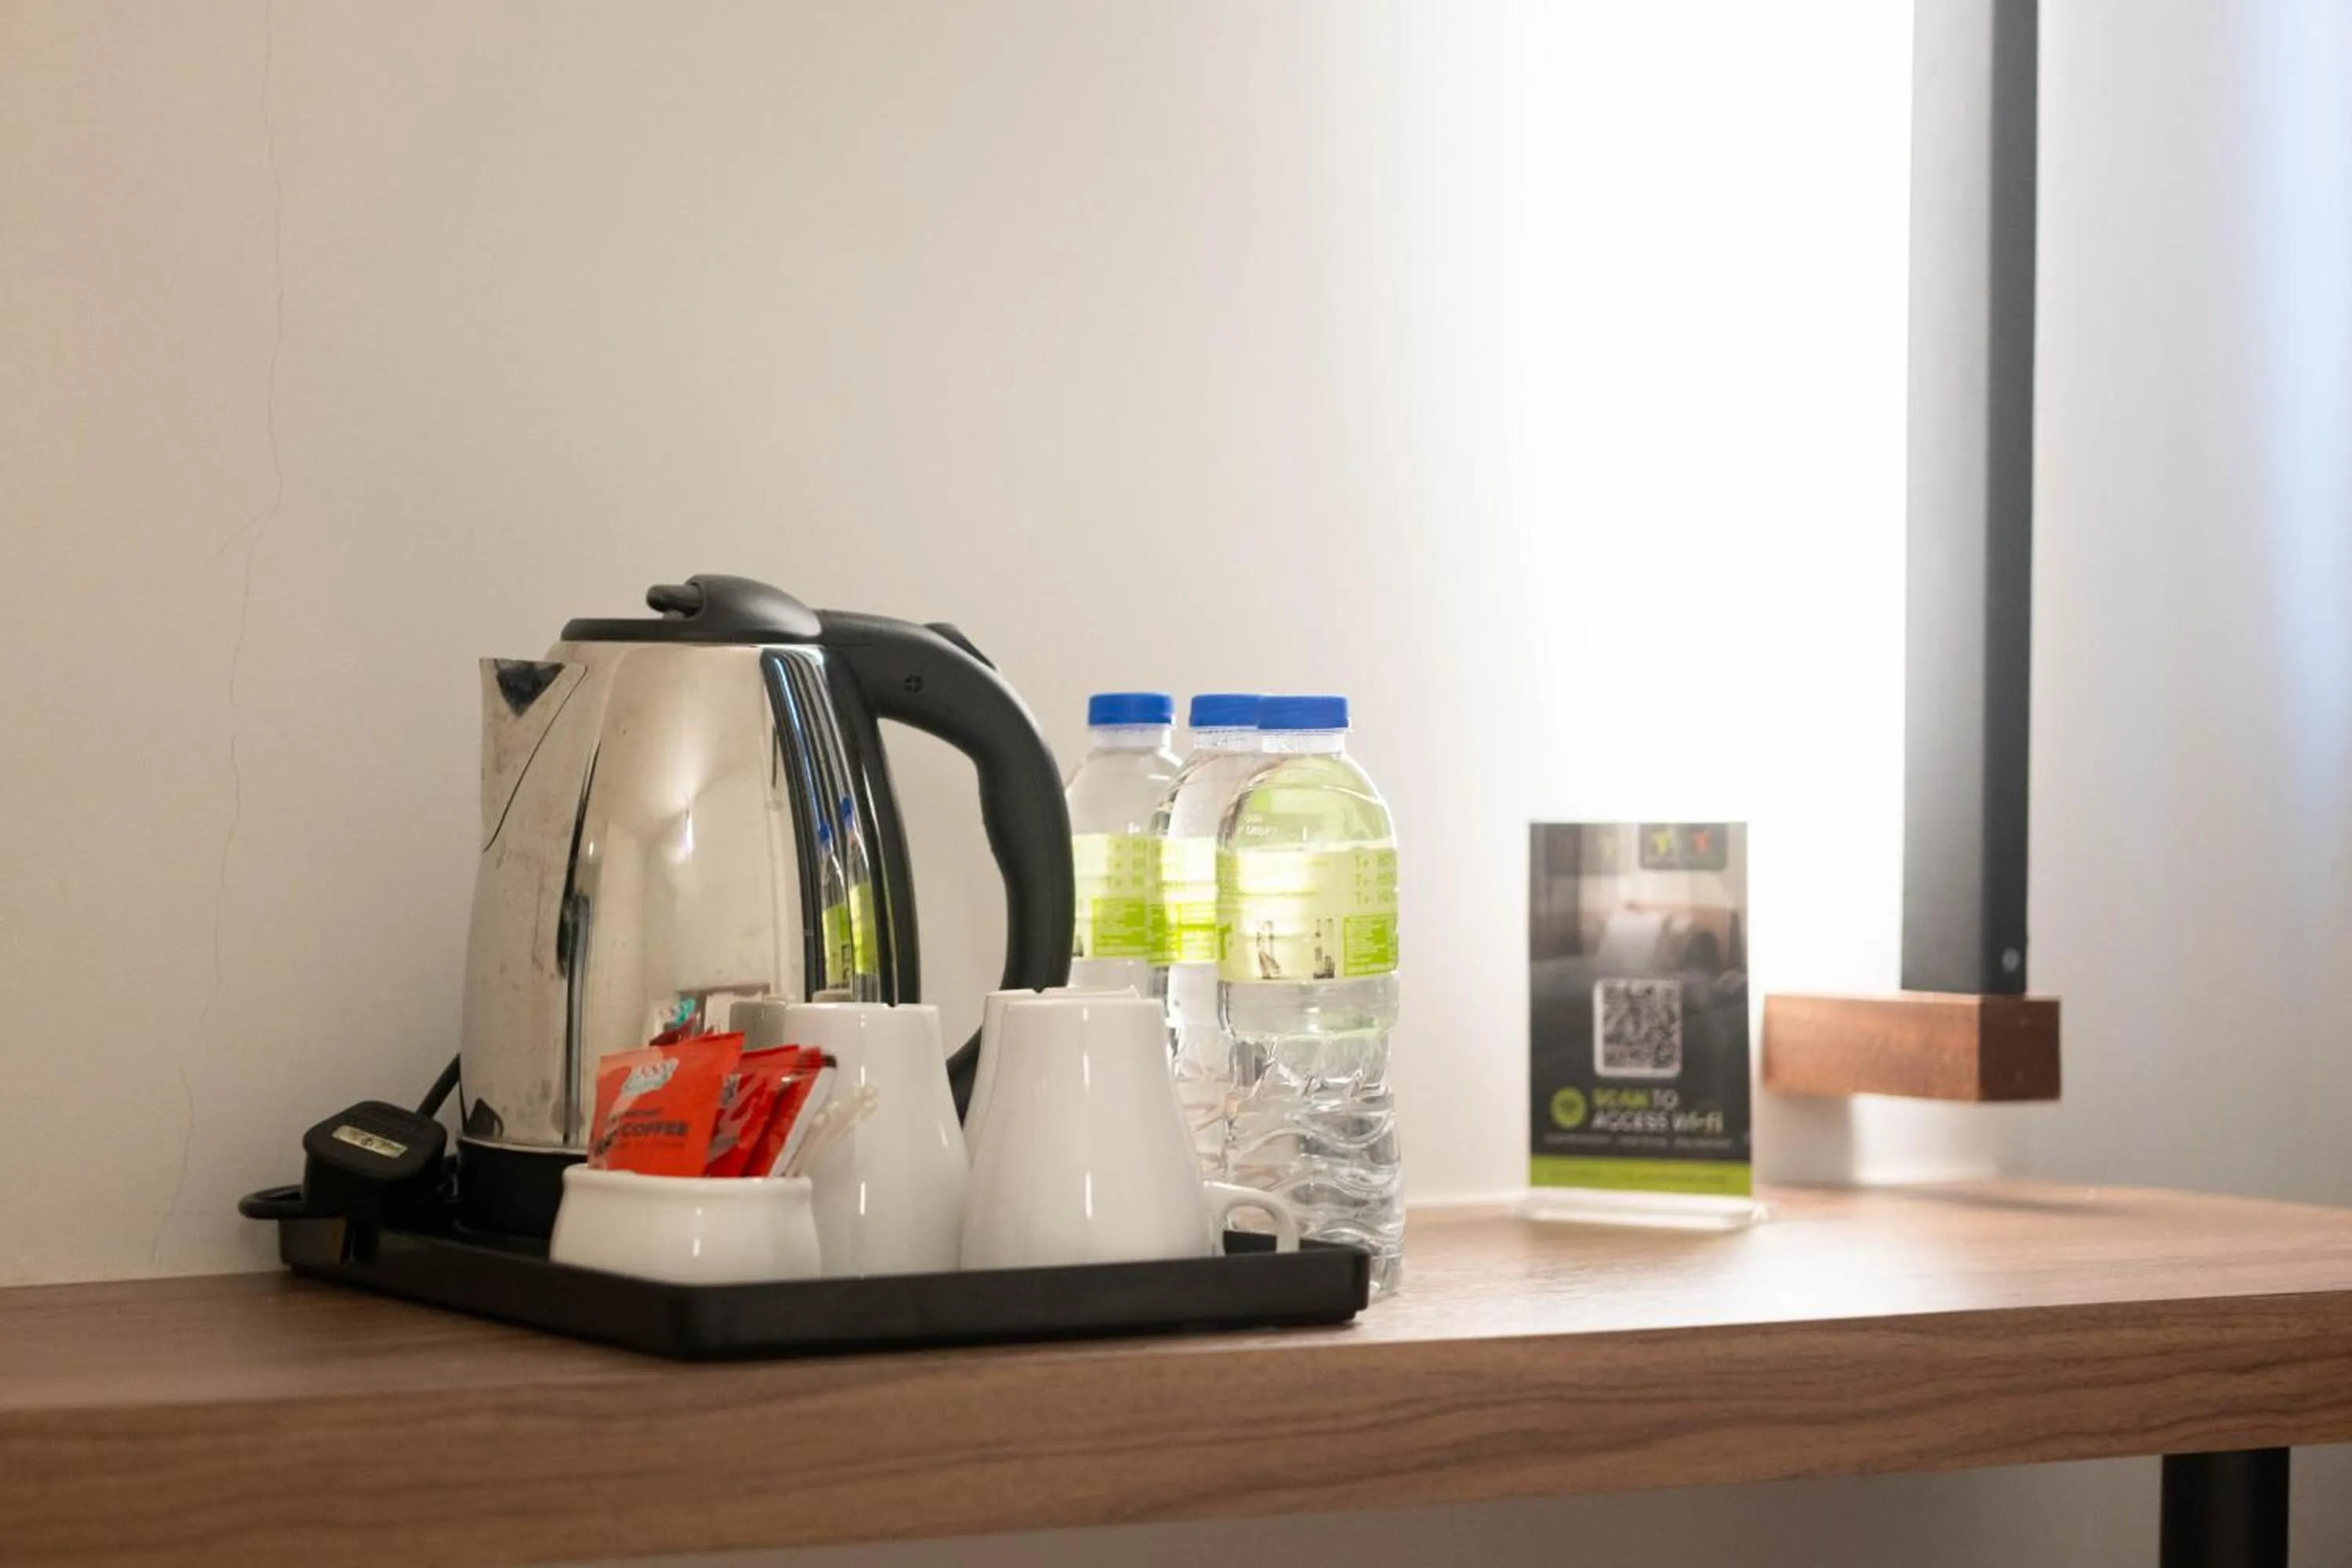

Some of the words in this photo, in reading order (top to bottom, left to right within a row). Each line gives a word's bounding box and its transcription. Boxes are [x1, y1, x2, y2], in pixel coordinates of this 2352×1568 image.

[1592, 1088, 1648, 1108] SCAN
[1652, 1088, 1680, 1110] TO
[620, 1121, 689, 1138] COFFEE
[1592, 1110, 1669, 1133] ACCESS
